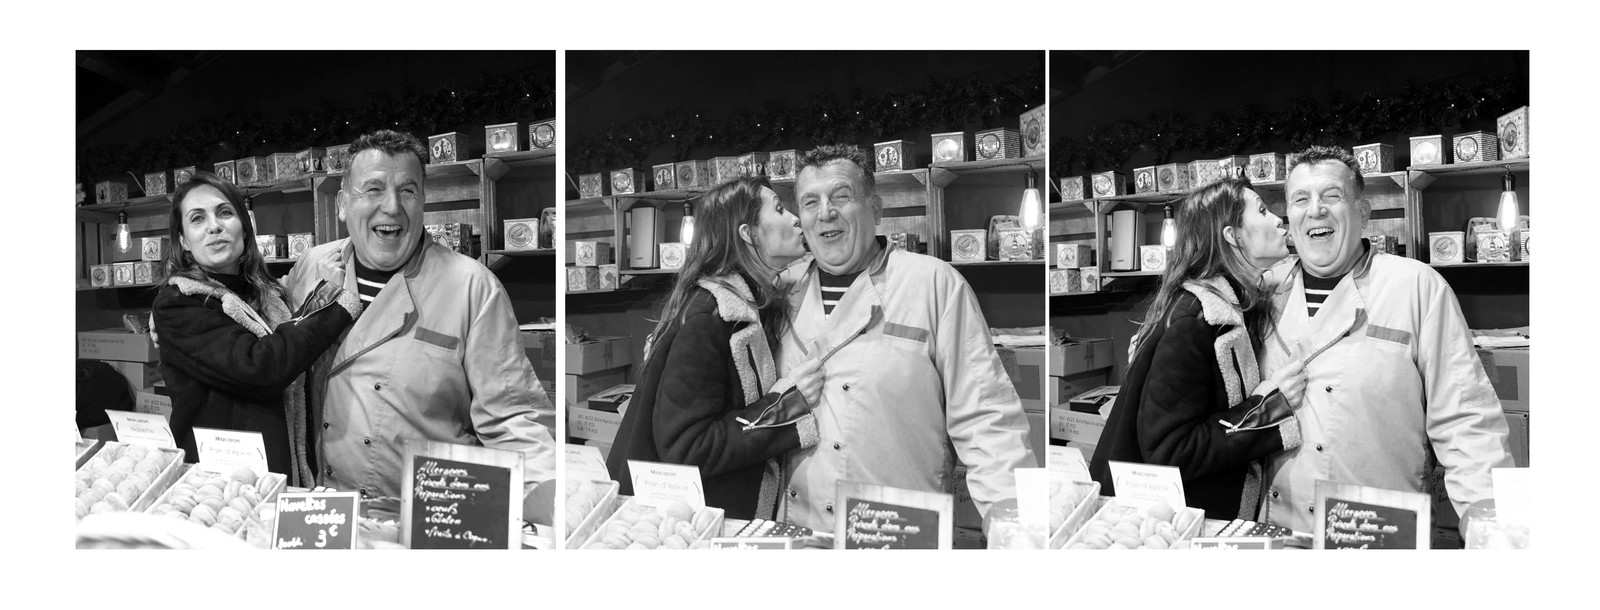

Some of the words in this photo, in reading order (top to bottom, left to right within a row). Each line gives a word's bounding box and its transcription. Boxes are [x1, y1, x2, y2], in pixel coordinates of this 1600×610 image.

[215, 436, 241, 444] Macaron
[650, 469, 677, 477] Macaron
[1131, 470, 1158, 478] Macaron
